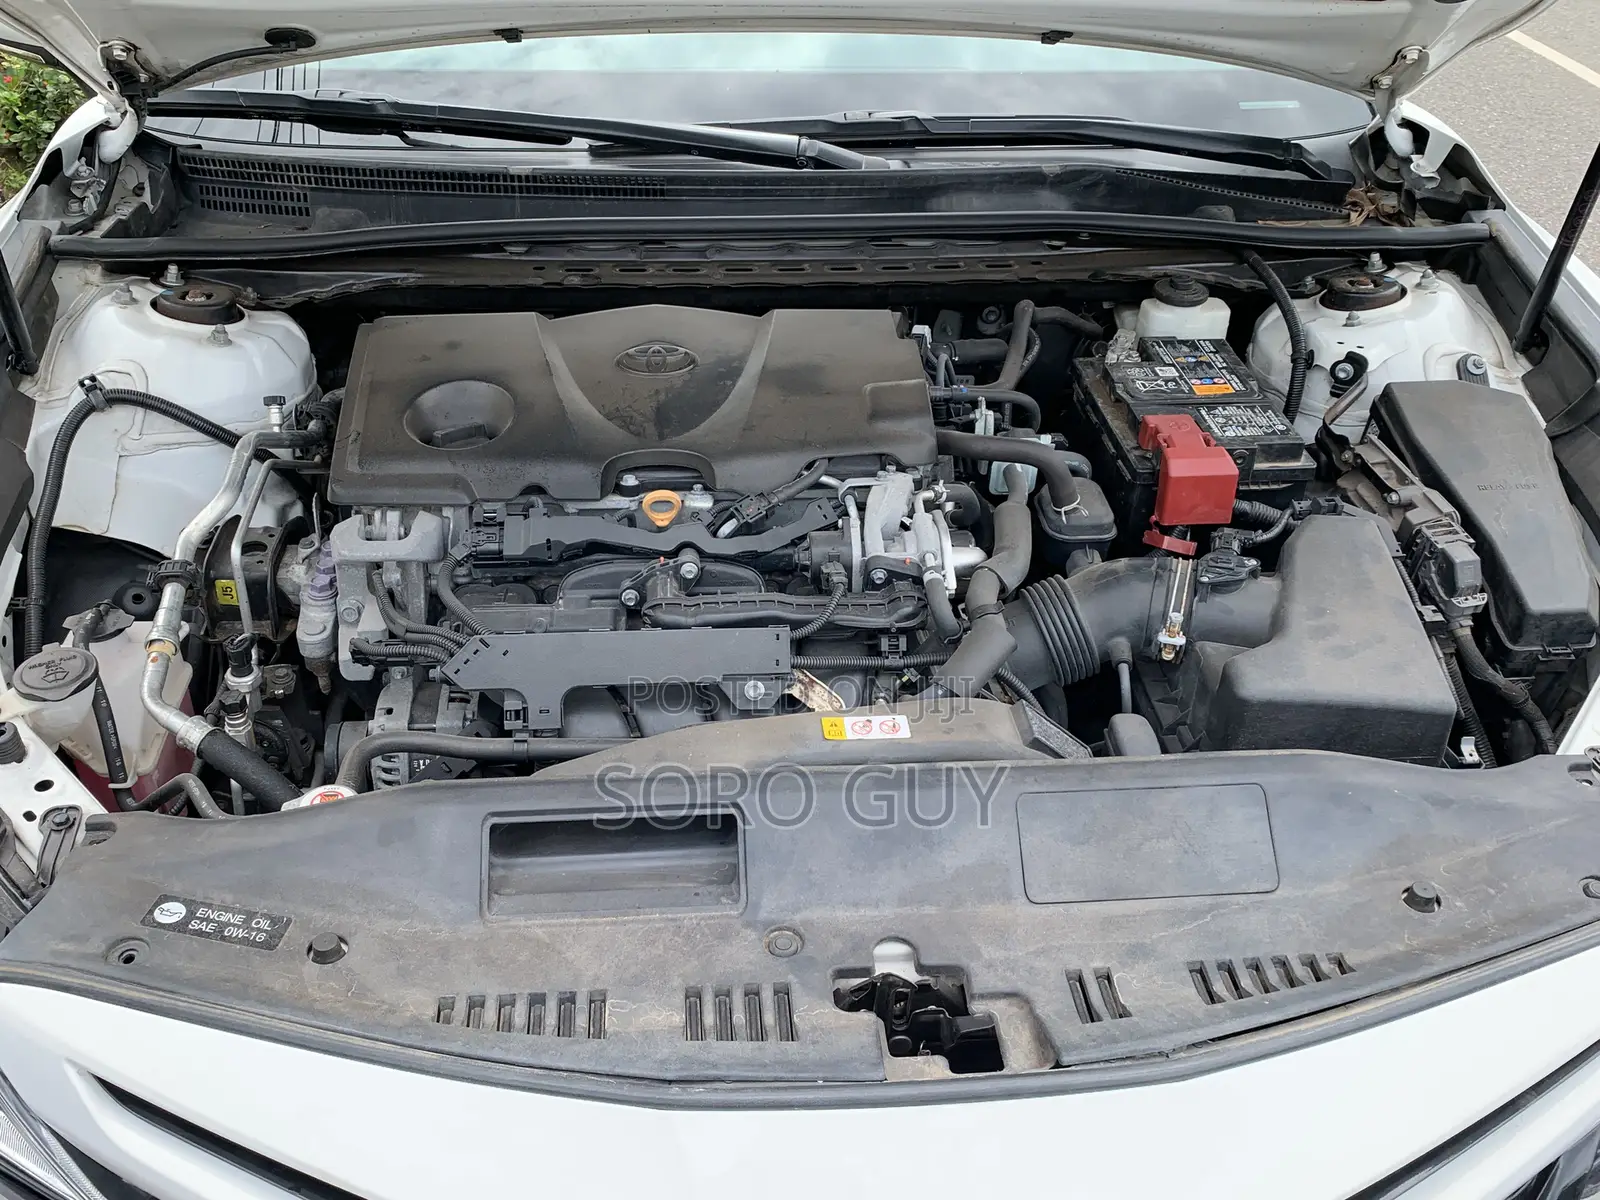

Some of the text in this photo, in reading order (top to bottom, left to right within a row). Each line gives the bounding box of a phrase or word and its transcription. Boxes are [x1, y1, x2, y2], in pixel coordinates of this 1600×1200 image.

[222, 586, 233, 599] J5
[28, 660, 56, 670] WASHER
[196, 907, 272, 931] ENGINE OIL
[188, 920, 266, 942] SAE 0W-16
